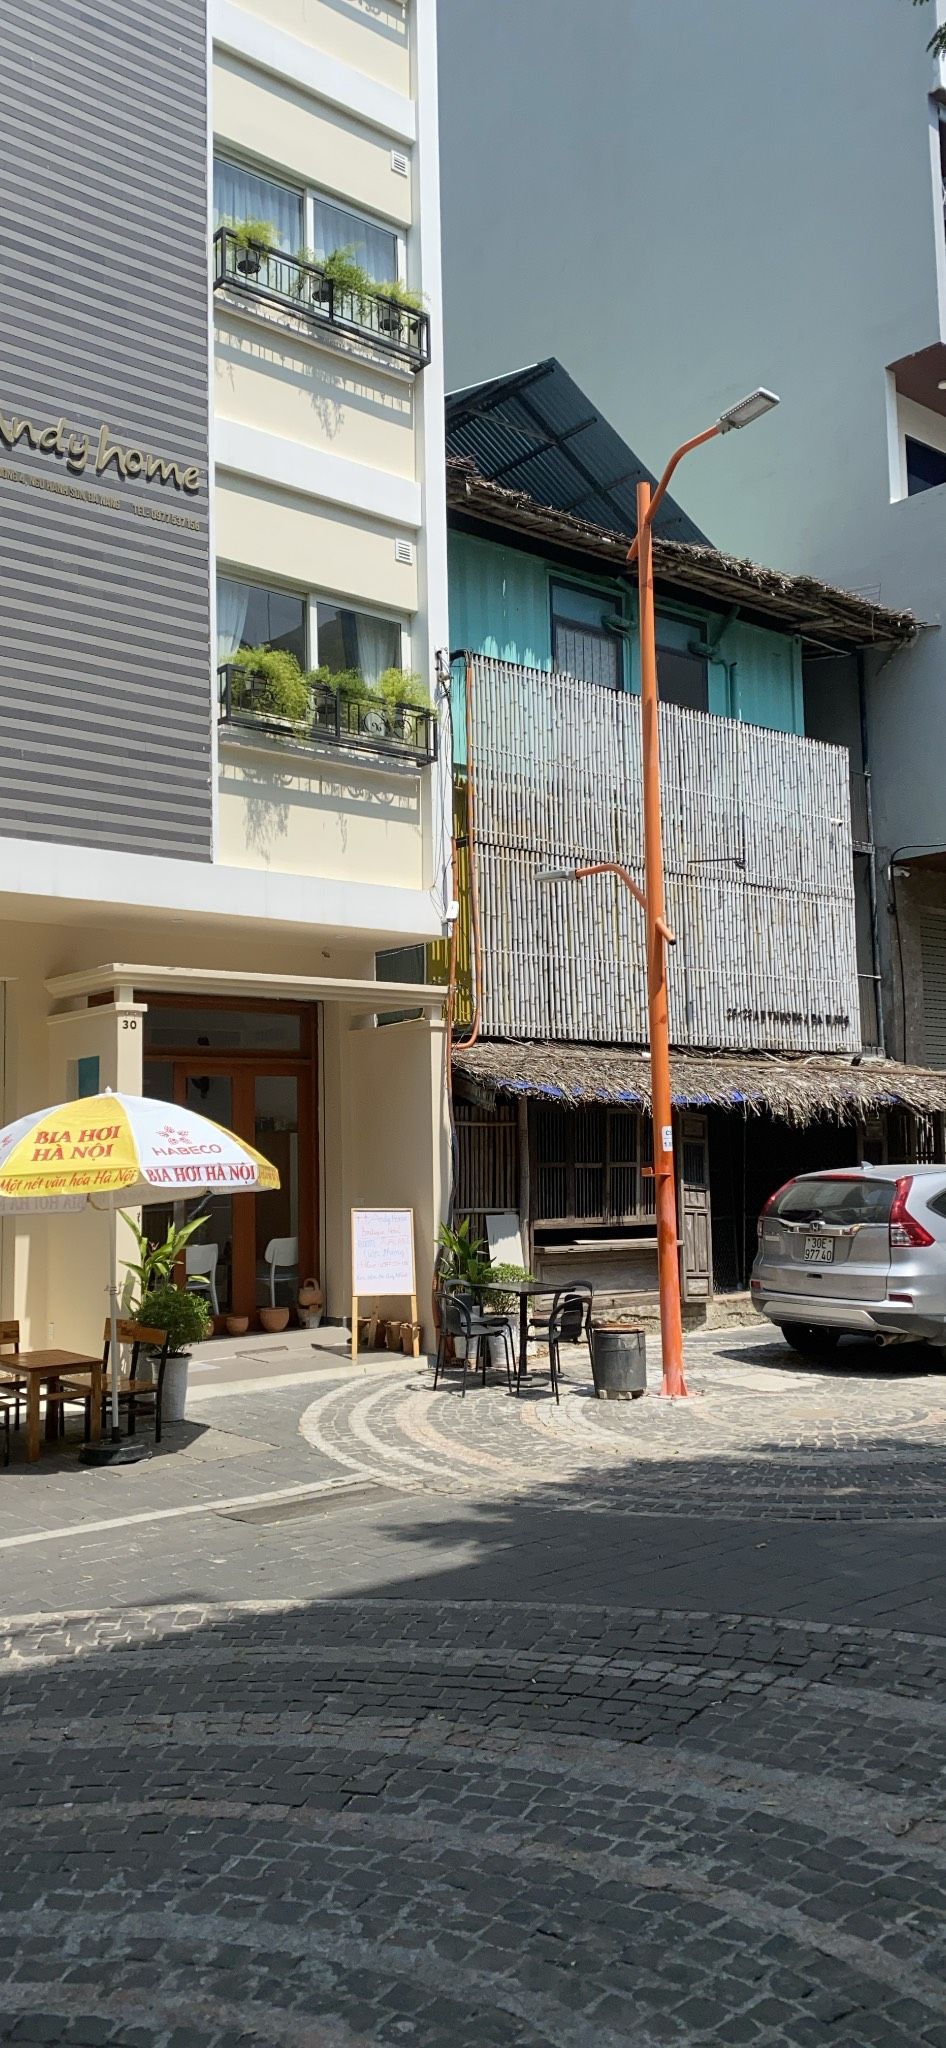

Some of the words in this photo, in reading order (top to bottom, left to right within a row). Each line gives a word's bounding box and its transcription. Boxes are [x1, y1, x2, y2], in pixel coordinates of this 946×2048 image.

[96, 424, 200, 490] home
[122, 1020, 137, 1030] 30
[34, 1130, 72, 1144] BIA
[78, 1125, 121, 1142] HƠI
[31, 1143, 64, 1161] HÀ
[70, 1142, 114, 1161] NỘI
[152, 1143, 222, 1156] HABECO
[0, 1177, 22, 1194] Một
[24, 1176, 44, 1191] nét
[45, 1176, 66, 1188] văn
[94, 1170, 112, 1185] Hà
[114, 1168, 137, 1185] Nội
[145, 1168, 173, 1182] BIA
[205, 1162, 227, 1180] HÀ
[229, 1162, 256, 1184] NỘI
[811, 1237, 827, 1249] 30E
